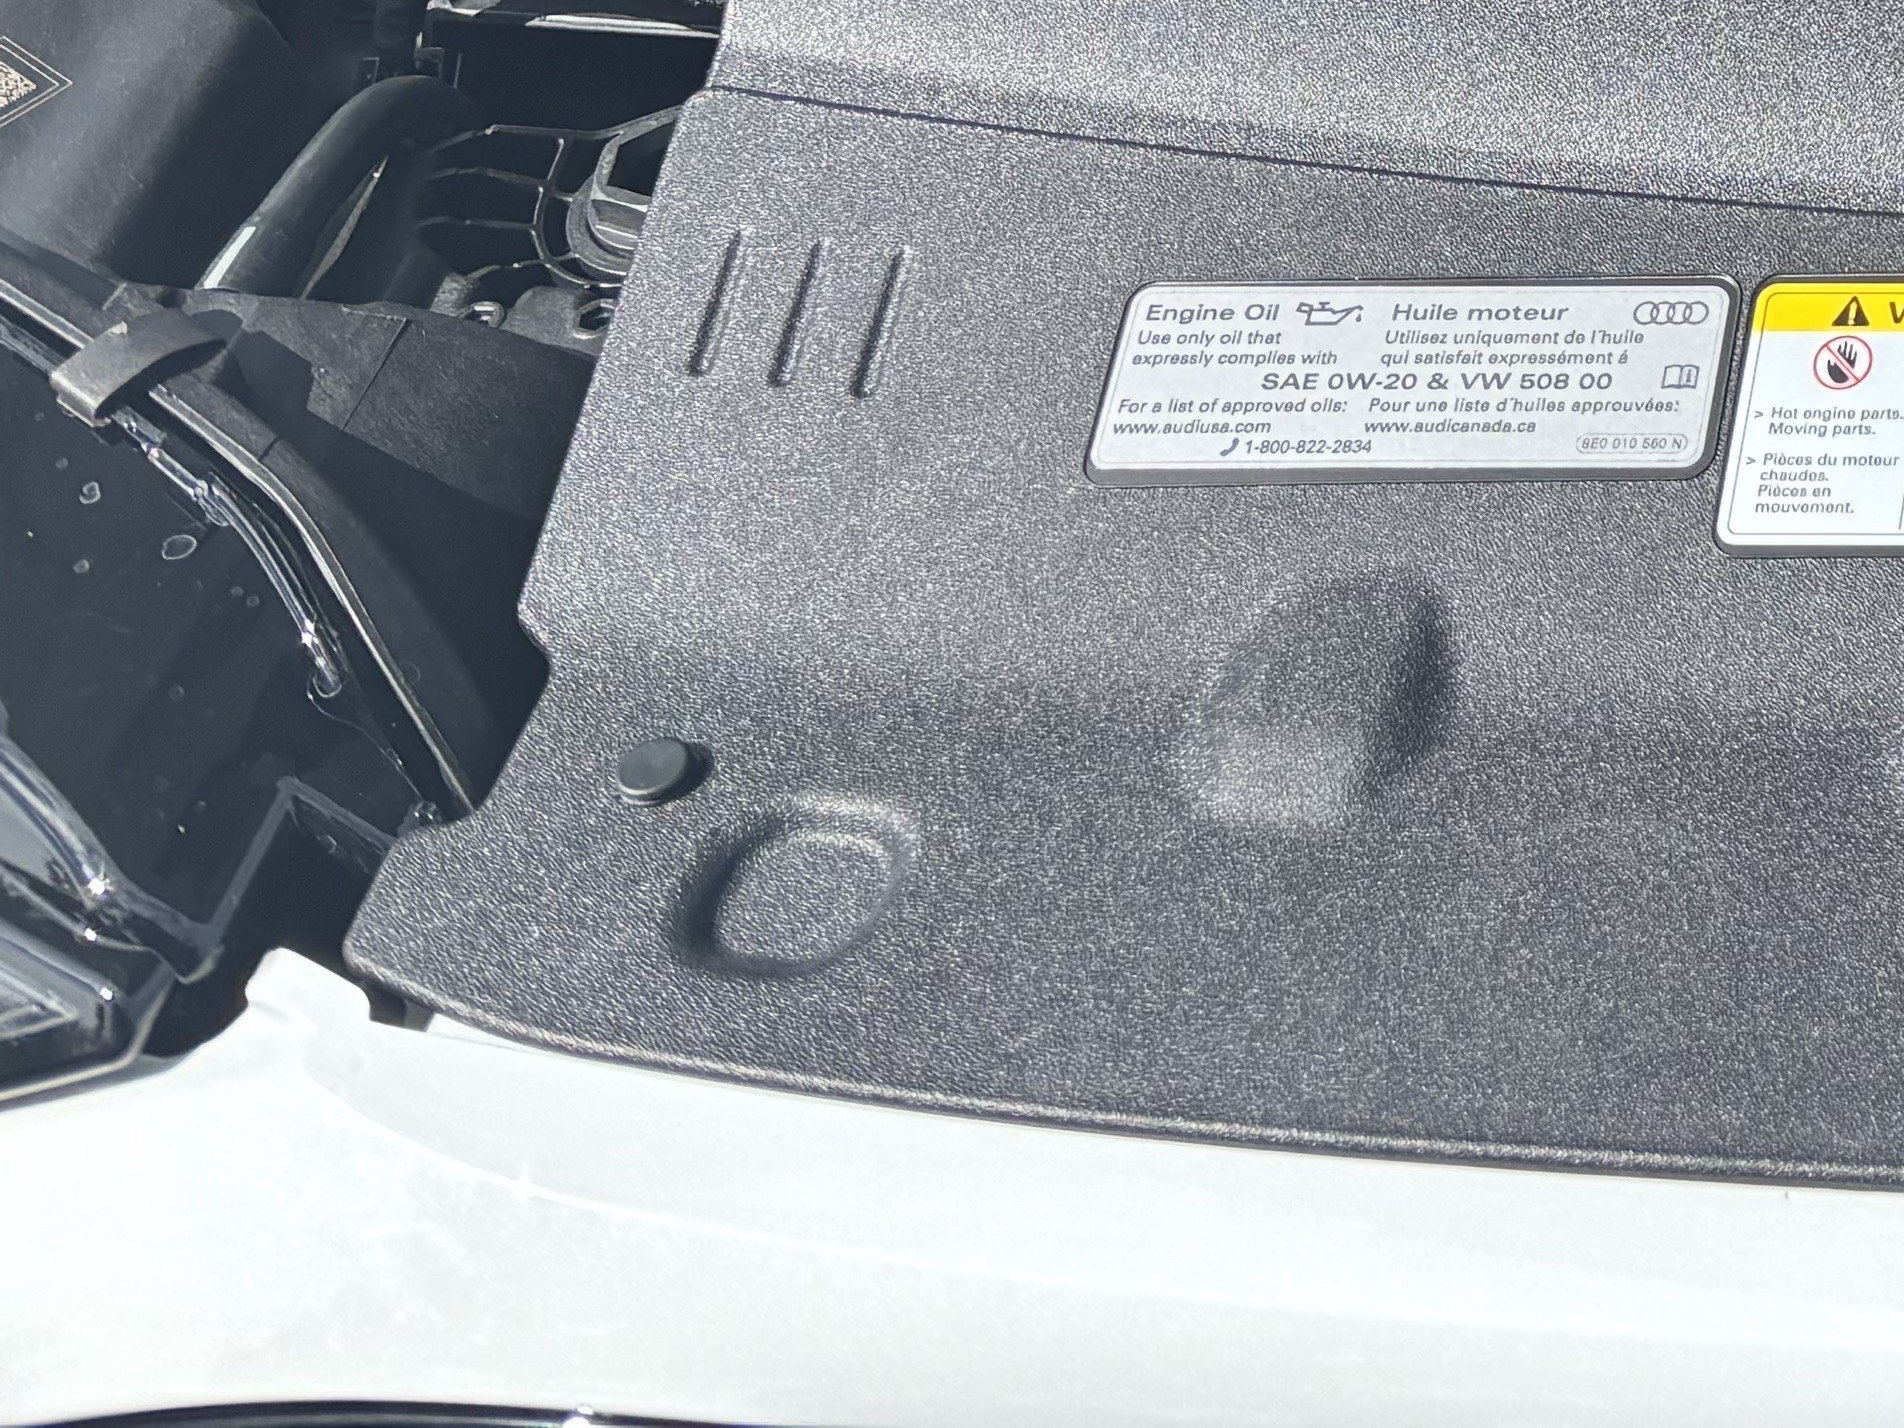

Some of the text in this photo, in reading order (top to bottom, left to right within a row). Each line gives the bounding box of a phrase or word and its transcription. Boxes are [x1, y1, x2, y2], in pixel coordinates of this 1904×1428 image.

[1146, 304, 1280, 324] Engine Oil
[1392, 304, 1569, 321] Huile moteur
[1138, 330, 1281, 347] Use only oil that
[1386, 330, 1447, 344] Utilisez
[1454, 330, 1559, 347] uniquement
[1564, 330, 1585, 344] de
[1132, 350, 1337, 368] expressly complies with
[1381, 350, 1409, 367] qui
[1414, 350, 1483, 364] satisfait
[1261, 372, 1612, 390] SAE 0W-20 & VW 508 00
[1118, 399, 1148, 413] For
[1152, 402, 1162, 413] a
[1168, 399, 1193, 412] list
[1199, 398, 1219, 413] of
[1222, 398, 1306, 415] approved
[1369, 398, 1411, 412] Pour
[1416, 401, 1447, 412] une
[1454, 398, 1490, 412] liste
[1771, 407, 1904, 422] Hot engine parts.
[1114, 419, 1271, 434] www.audiusa.com
[1365, 419, 1536, 433] www.audicanada.ca
[1769, 422, 1876, 437] Moving parts.
[1246, 440, 1371, 454] 1-800-822-2834
[1672, 437, 1682, 449] N
[1818, 453, 1837, 466] du
[1843, 455, 1899, 466] moteur
[1760, 470, 1828, 481] chaudes.
[1812, 488, 1831, 497] en
[1755, 503, 1854, 513] mouvement.
